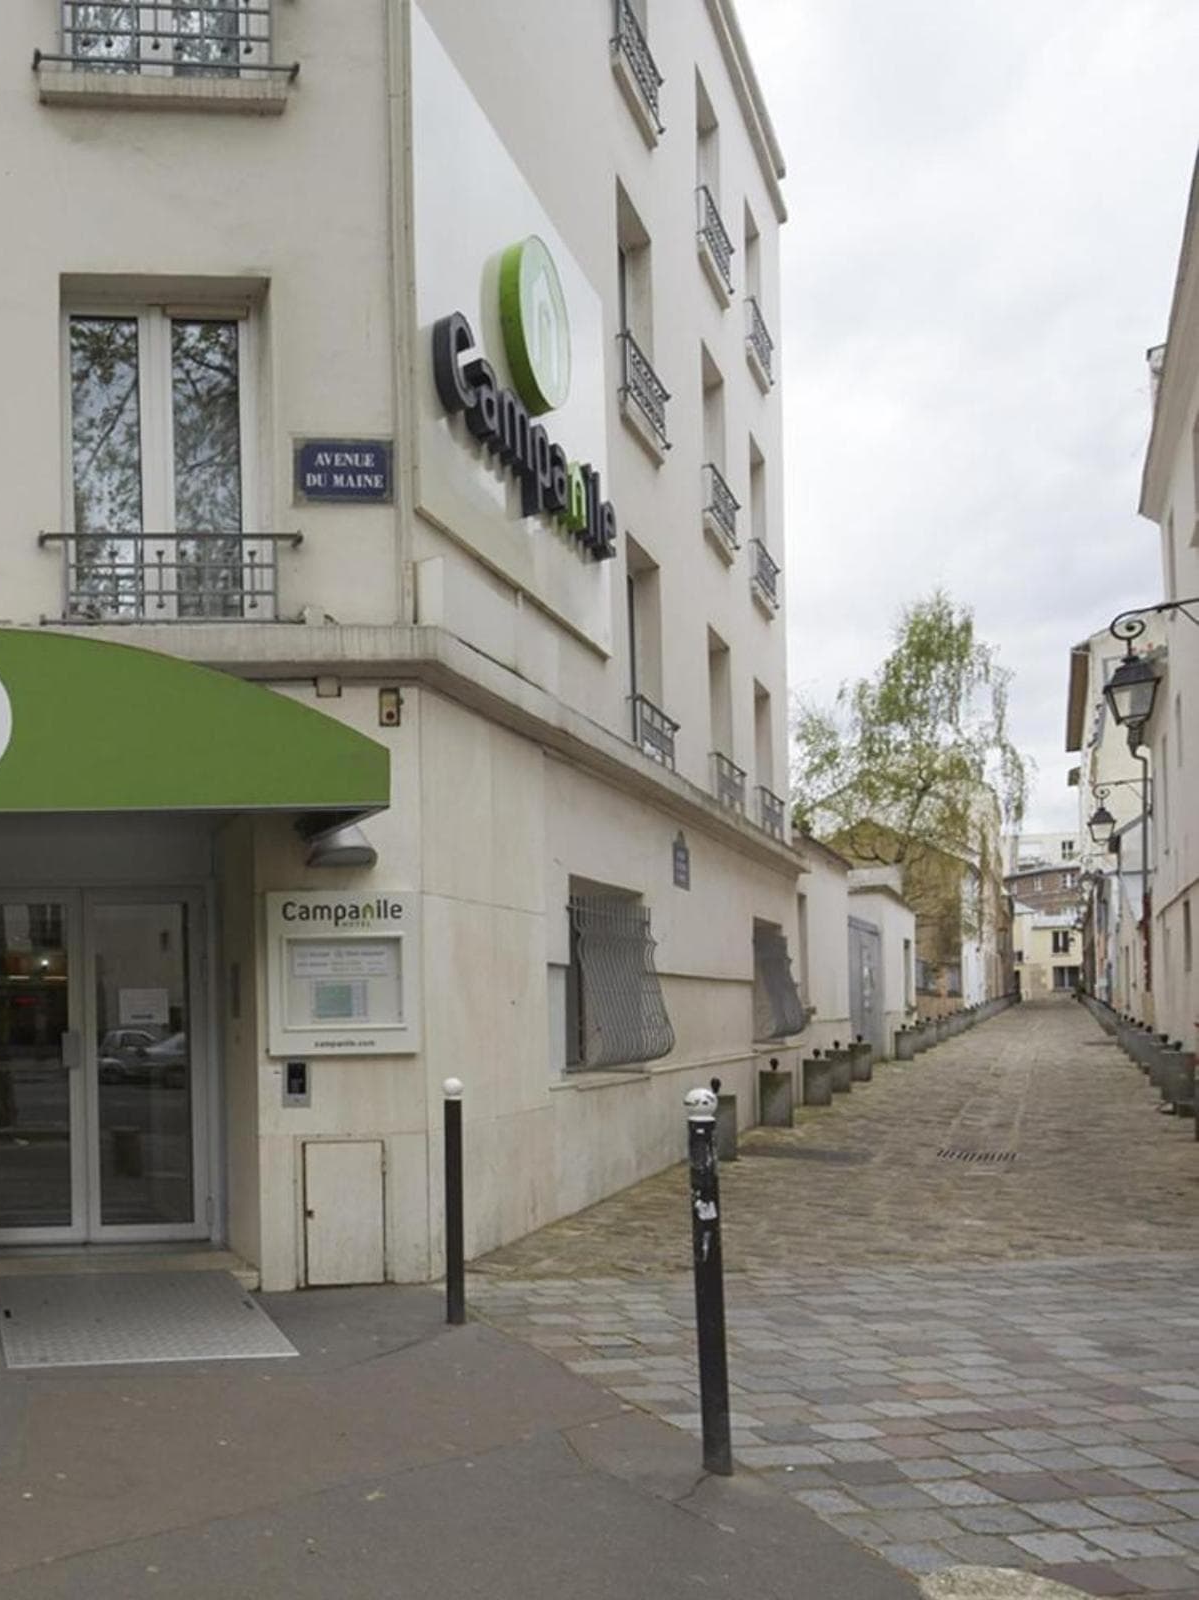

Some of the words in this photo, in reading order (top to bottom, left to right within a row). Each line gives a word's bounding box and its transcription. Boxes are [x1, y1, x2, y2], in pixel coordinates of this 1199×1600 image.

[432, 311, 616, 562] Campanile
[314, 453, 375, 468] AVENUE
[306, 473, 327, 487] DU
[332, 474, 384, 488] MAINE
[282, 899, 403, 927] Campanile
